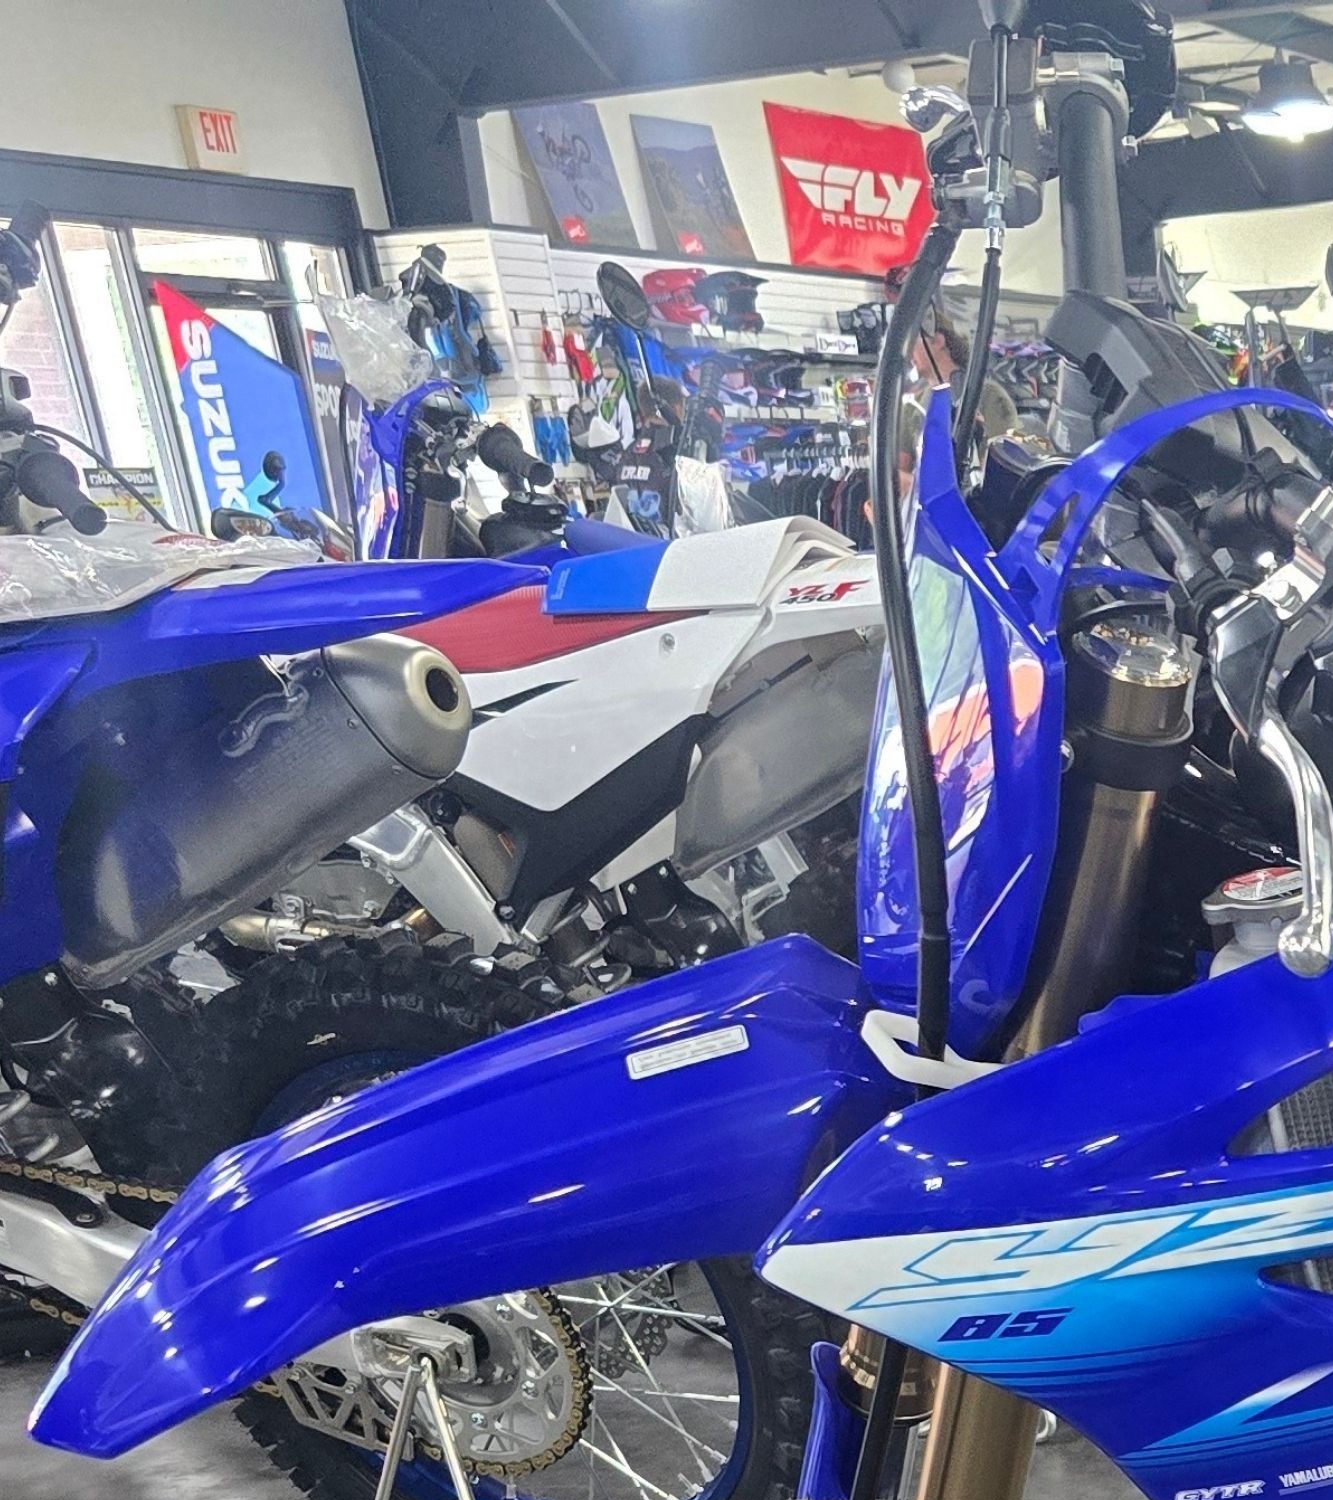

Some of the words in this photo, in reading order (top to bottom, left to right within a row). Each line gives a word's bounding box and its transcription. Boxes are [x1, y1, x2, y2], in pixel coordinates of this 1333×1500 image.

[199, 111, 237, 154] EXIT
[780, 156, 922, 222] FLY
[821, 212, 905, 237] RACING
[180, 319, 250, 511] SUZUK
[89, 473, 153, 486] CHAPION
[938, 1307, 1073, 1343] 85
